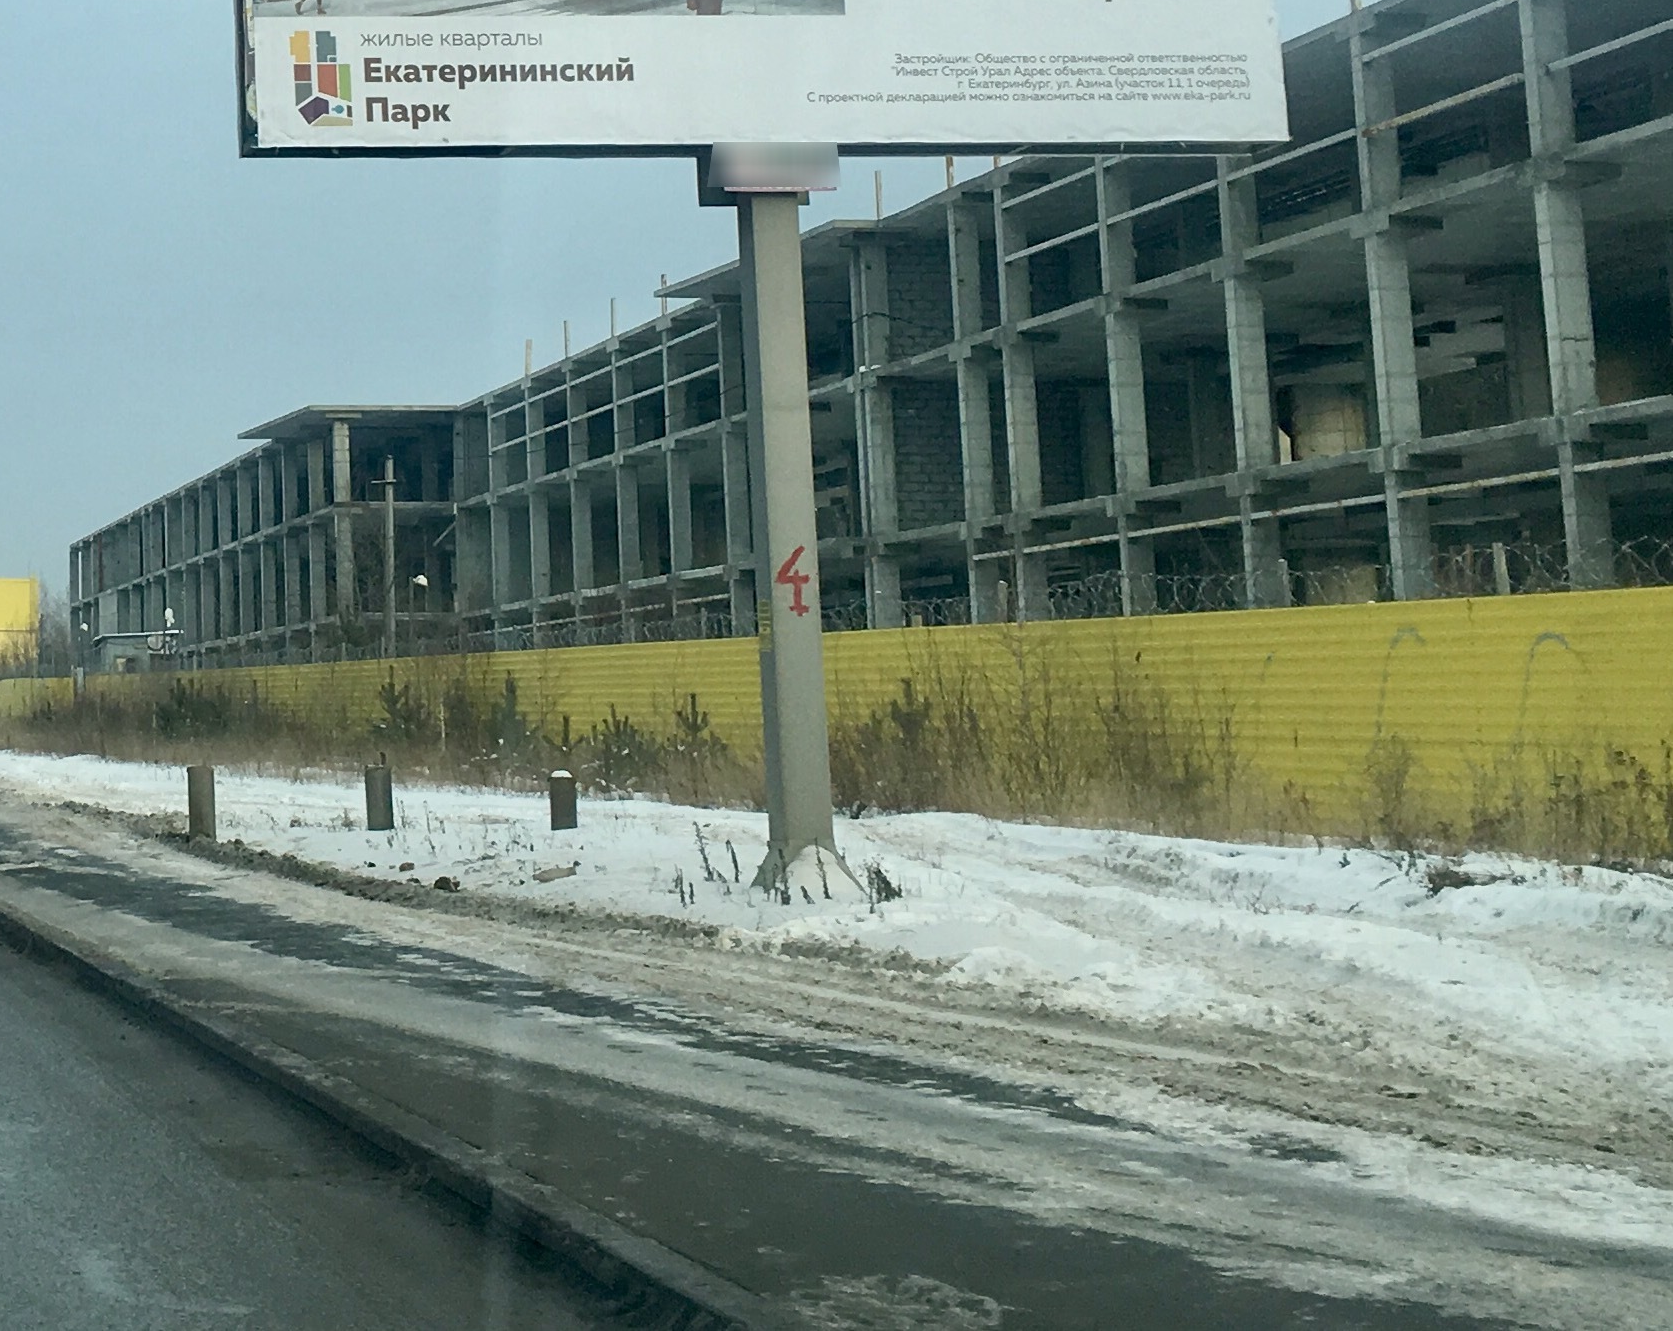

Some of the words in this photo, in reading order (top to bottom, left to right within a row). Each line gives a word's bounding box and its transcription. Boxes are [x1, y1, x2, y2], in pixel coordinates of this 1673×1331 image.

[360, 32, 434, 47] жилые
[440, 31, 543, 51] кварталы
[974, 52, 1037, 64] Общество
[1048, 53, 1135, 65] ограниченной
[1137, 54, 1248, 63] ответственностью
[364, 57, 634, 90] Екатерининский
[941, 65, 978, 78] Строй
[1013, 65, 1052, 78] Адрес
[1108, 65, 1194, 77] Свердловская
[1076, 78, 1113, 88] Азина
[1114, 77, 1164, 91] (участок
[1196, 75, 1250, 90] очередь)
[806, 92, 816, 103] С
[818, 92, 883, 104] проектной
[886, 92, 966, 104] декларацией
[969, 93, 1009, 102] можно
[1012, 91, 1095, 102] ознакомиться
[1098, 93, 1113, 101] на
[1115, 90, 1149, 101] сайте
[366, 97, 451, 129] Парк
